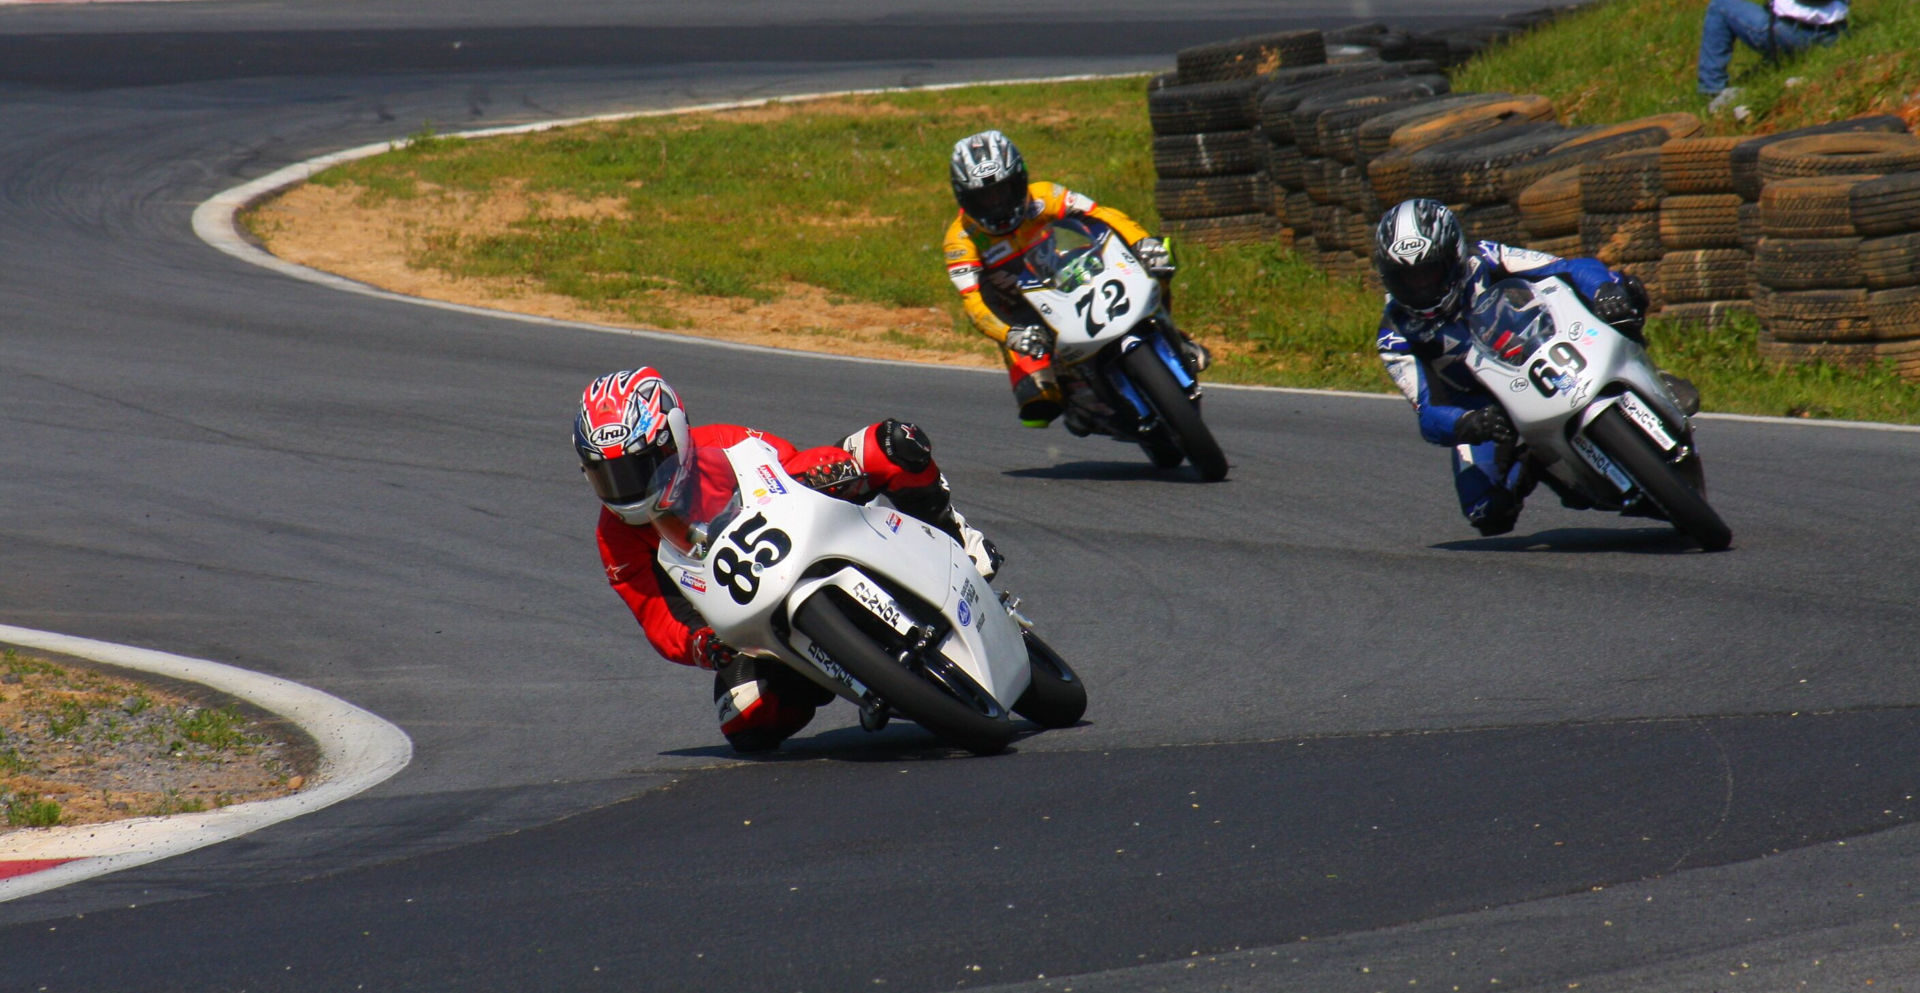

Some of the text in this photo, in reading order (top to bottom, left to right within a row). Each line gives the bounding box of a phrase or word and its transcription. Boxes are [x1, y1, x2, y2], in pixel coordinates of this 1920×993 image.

[1074, 279, 1131, 338] 72
[1528, 341, 1588, 399] 69
[592, 426, 626, 444] Arai
[713, 511, 793, 606] 85
[852, 582, 901, 628] DUNLOP
